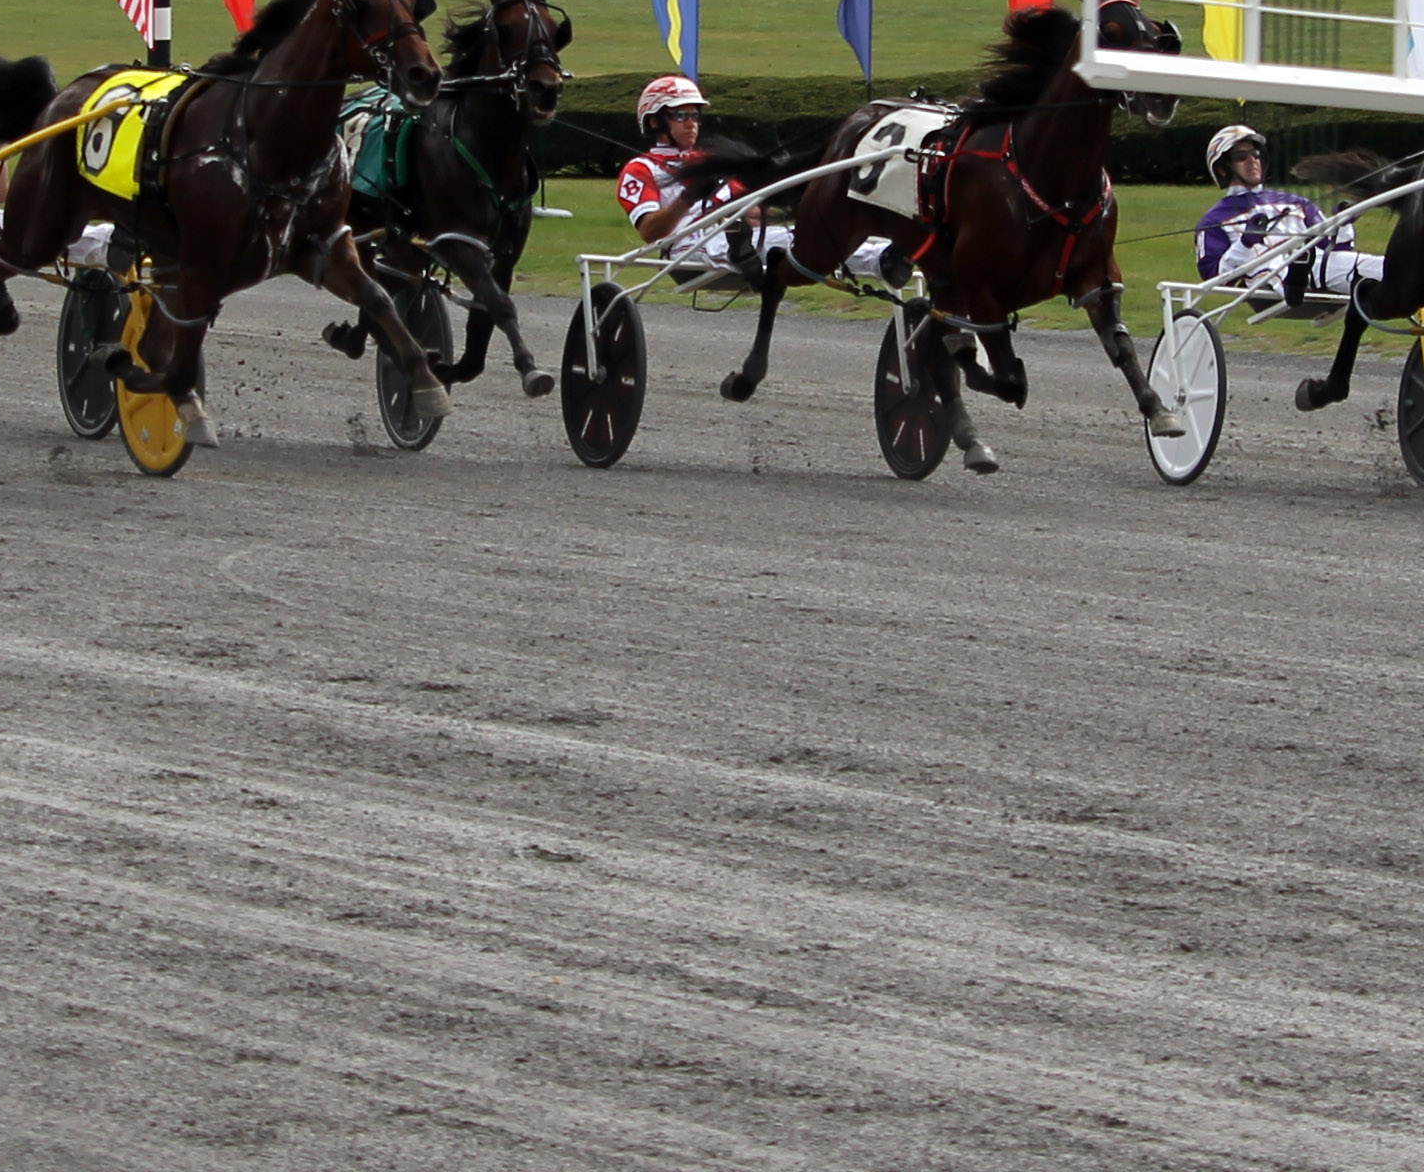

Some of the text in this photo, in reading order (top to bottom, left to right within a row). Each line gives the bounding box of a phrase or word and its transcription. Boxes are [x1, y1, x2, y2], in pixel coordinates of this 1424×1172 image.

[84, 84, 137, 172] 6
[849, 121, 907, 196] 3
[623, 179, 641, 197] B
